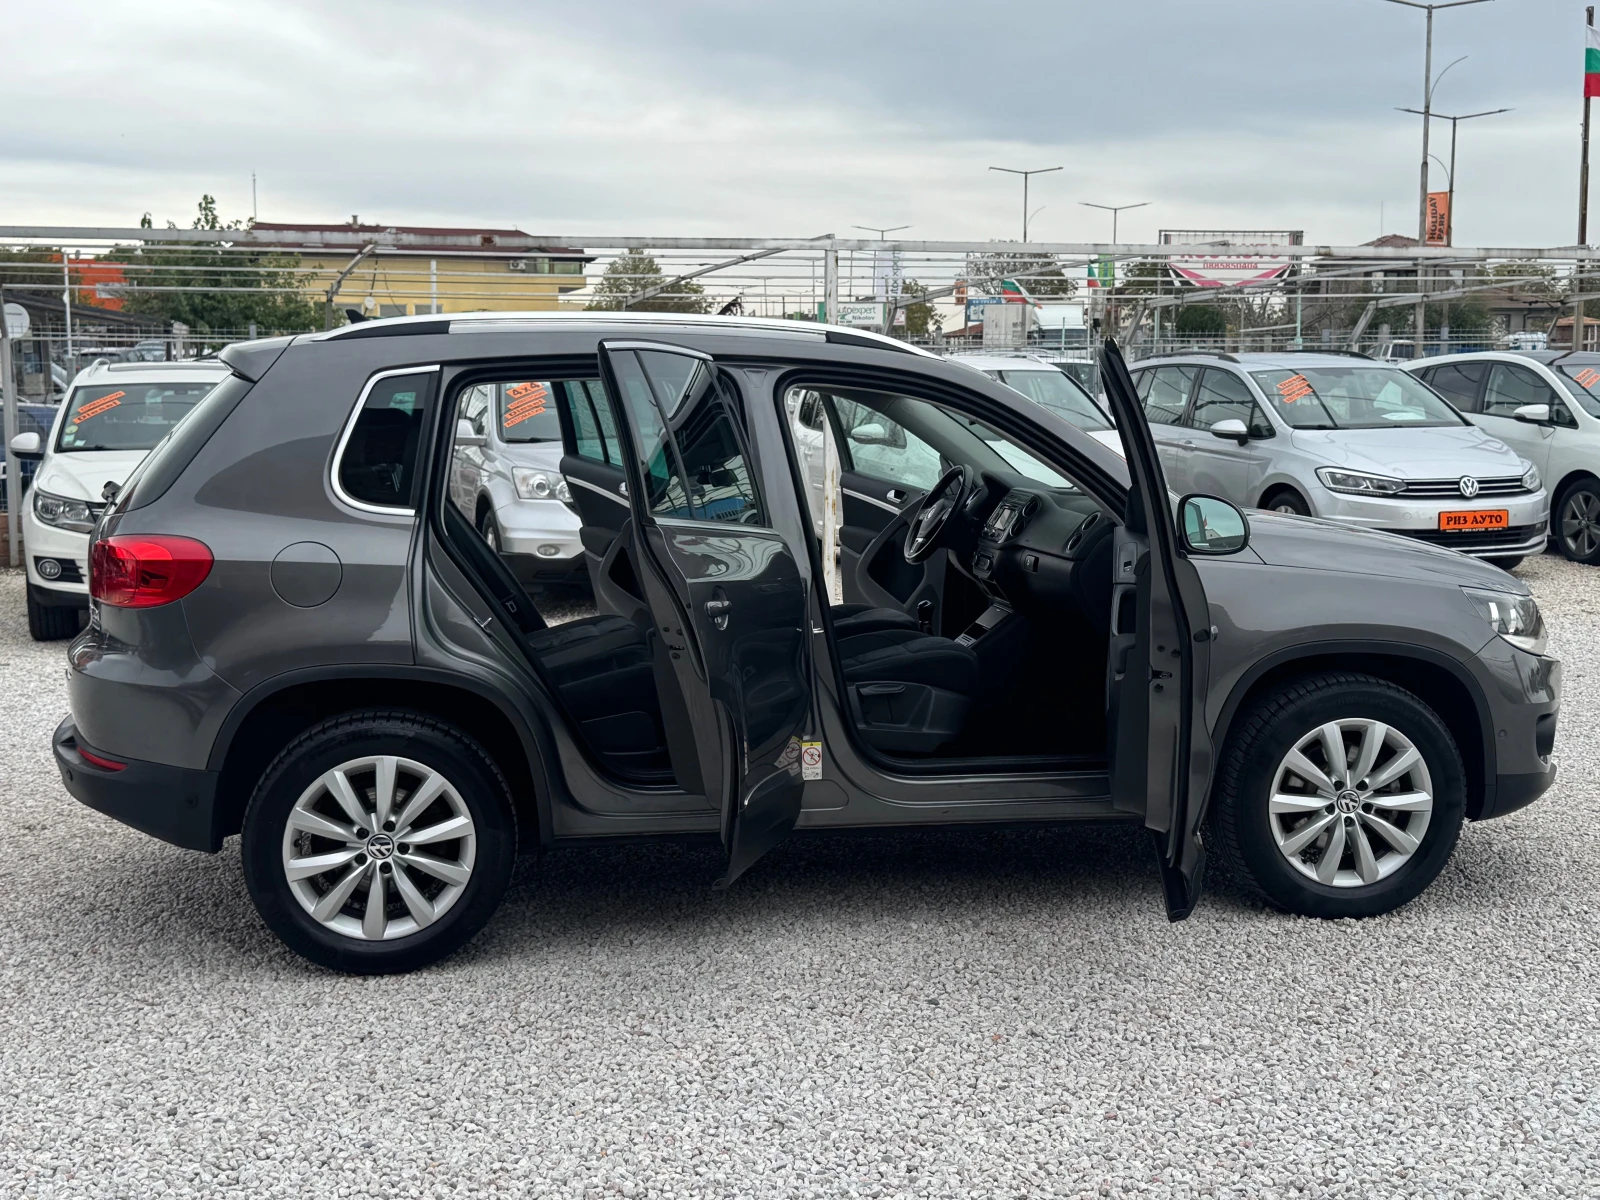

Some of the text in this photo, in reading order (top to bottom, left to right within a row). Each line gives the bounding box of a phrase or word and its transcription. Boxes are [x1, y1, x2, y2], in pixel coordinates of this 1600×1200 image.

[1428, 196, 1438, 240] HOLIDAY
[1437, 213, 1446, 240] PARK
[838, 305, 876, 316] utoexpert
[1446, 514, 1503, 526] РИЗ АУТО
